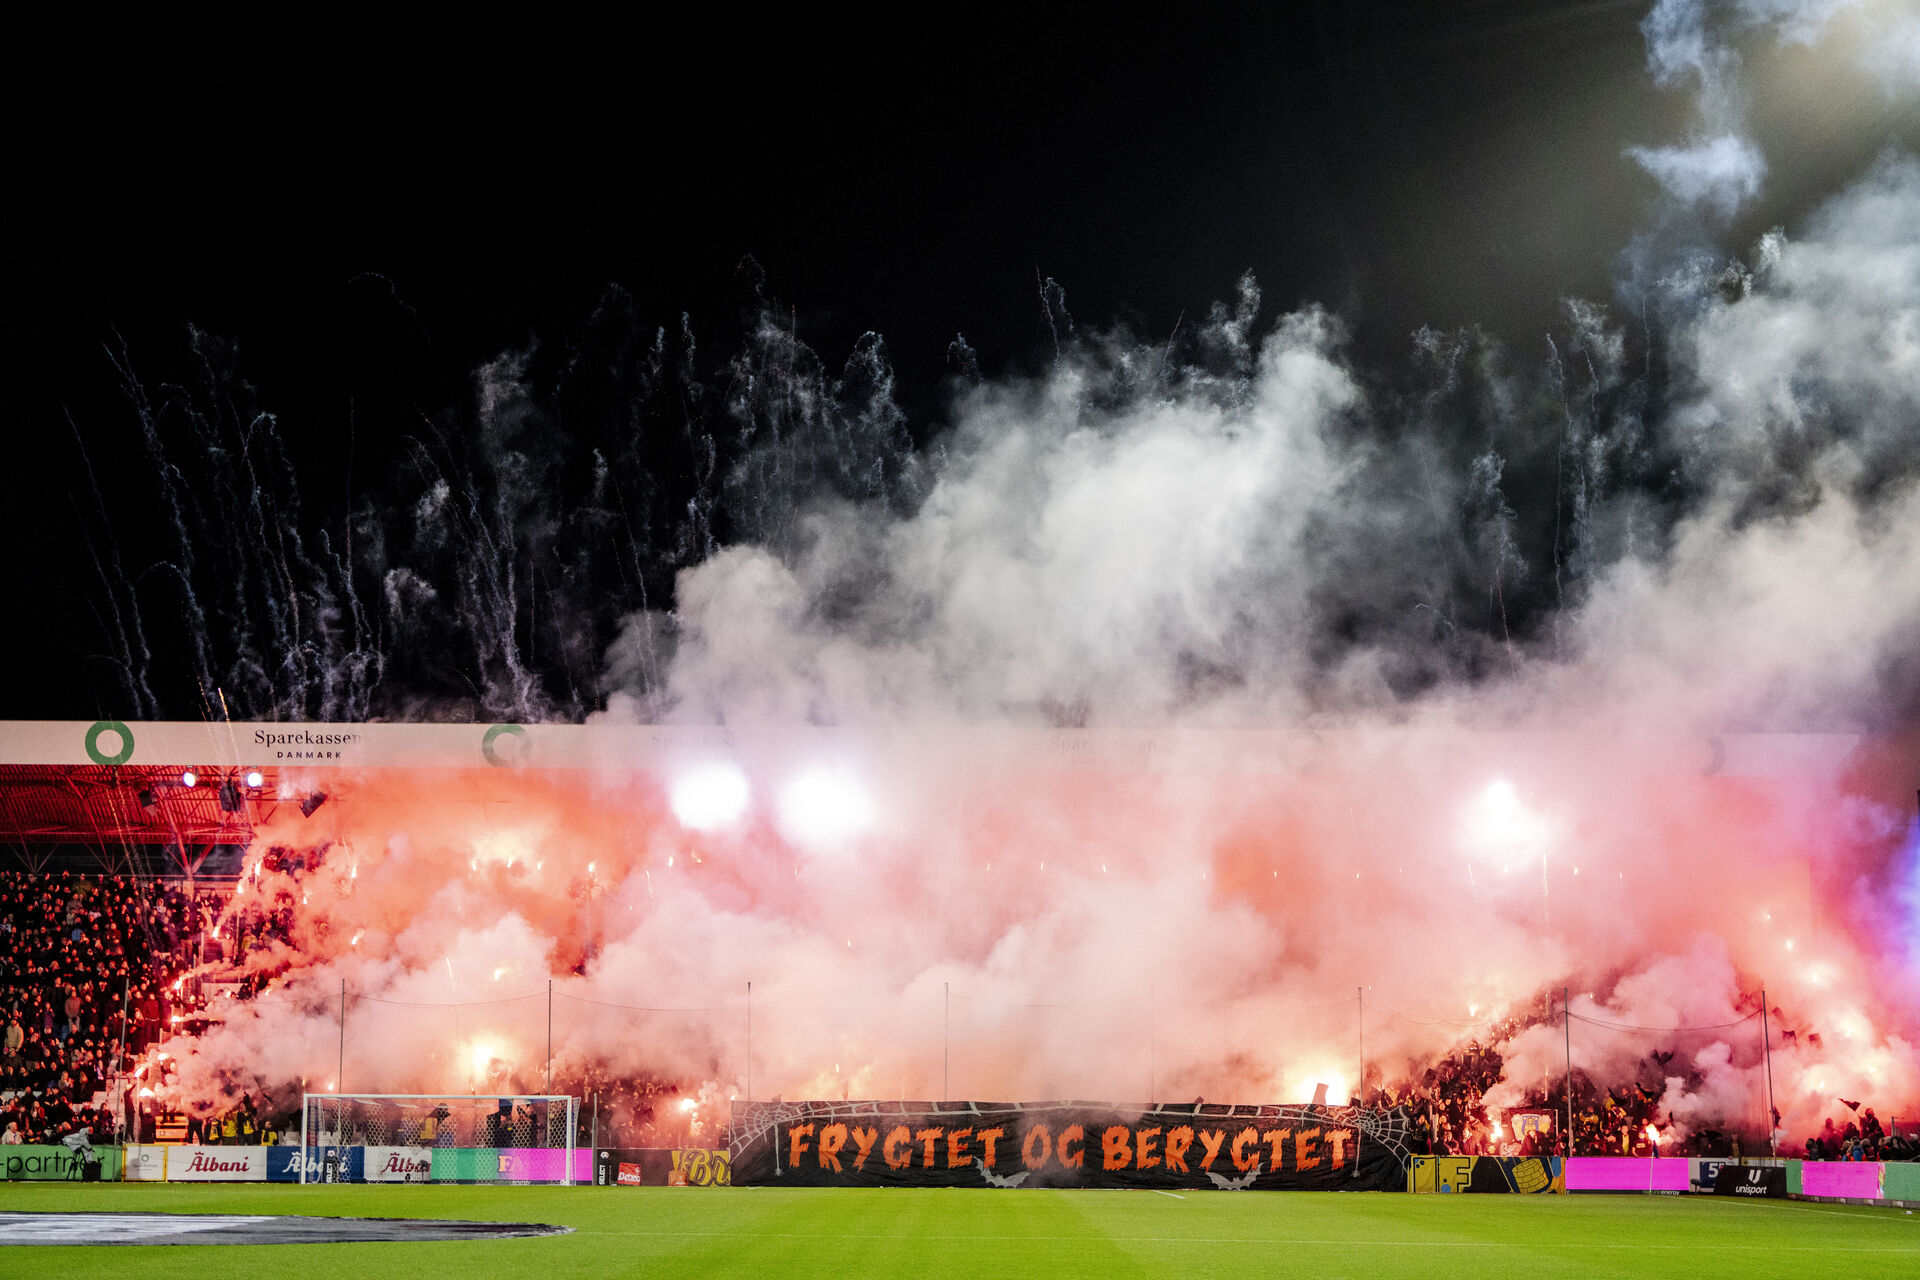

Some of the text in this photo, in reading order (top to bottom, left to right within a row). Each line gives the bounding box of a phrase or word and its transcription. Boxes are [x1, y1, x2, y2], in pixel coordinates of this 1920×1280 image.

[254, 729, 361, 748] Sparekassen
[277, 751, 341, 759] DANMARK
[789, 1121, 1352, 1174] FRYGTET OG BERYGTET
[185, 1152, 250, 1173] Albani
[1735, 1184, 1768, 1195] unisport
